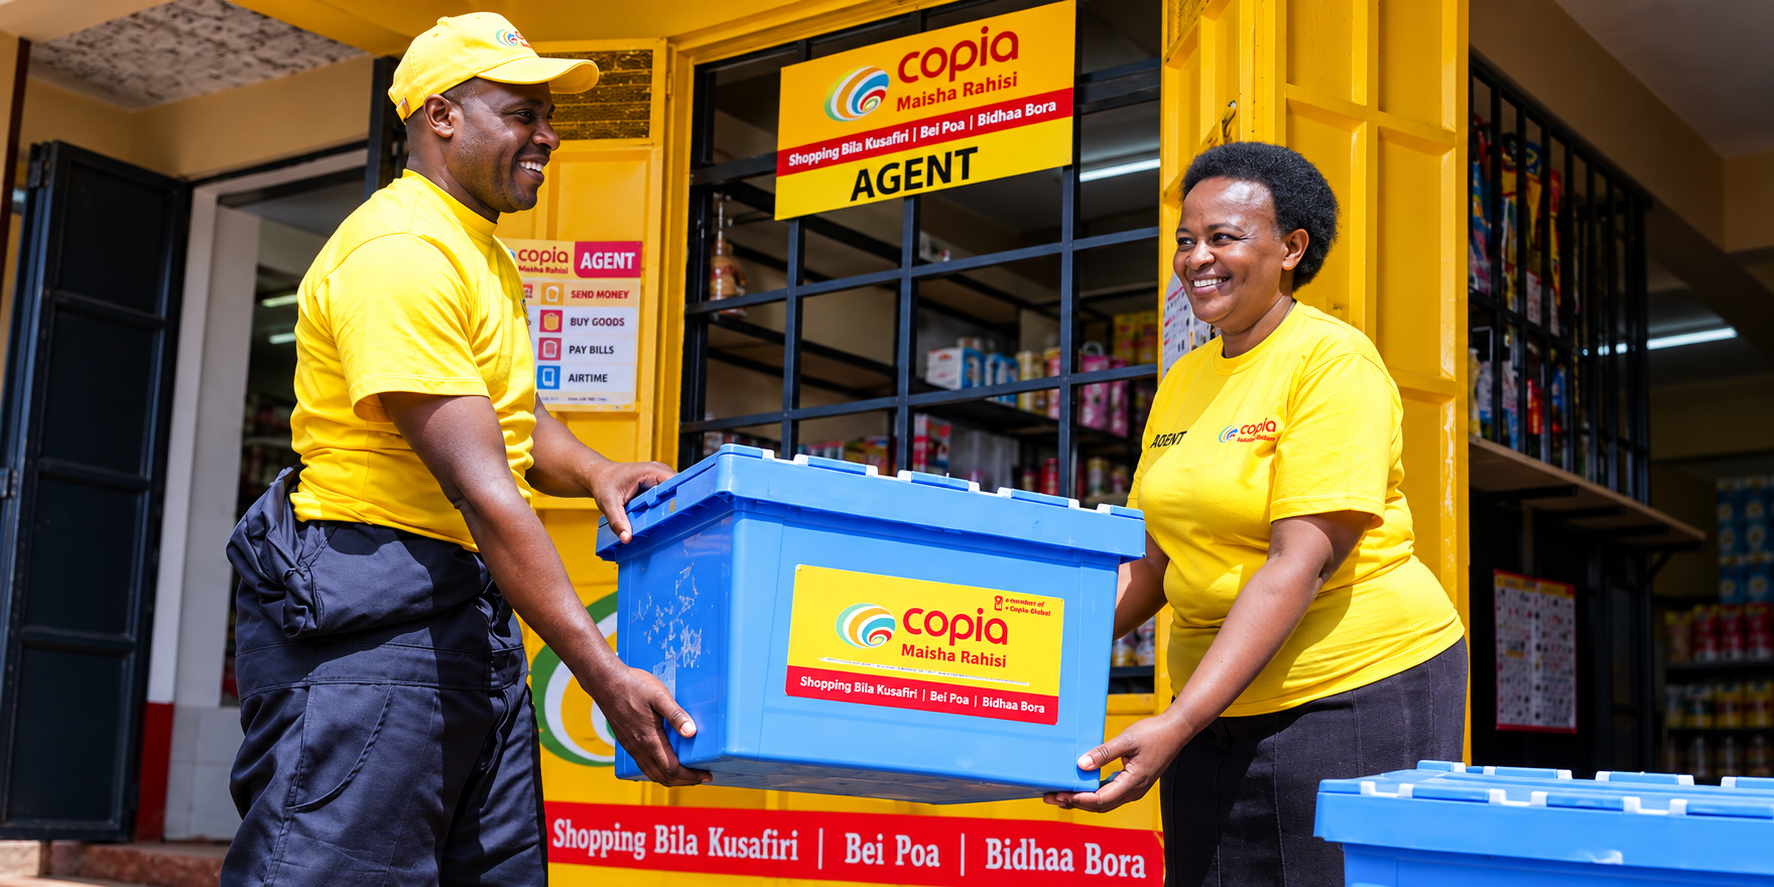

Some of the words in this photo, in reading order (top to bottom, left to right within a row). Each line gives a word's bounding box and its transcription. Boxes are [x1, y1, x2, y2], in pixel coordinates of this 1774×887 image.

[898, 25, 1019, 83] copia
[896, 88, 957, 112] Maisha
[962, 71, 1018, 99] Rahisi
[788, 146, 839, 167] Shopping
[841, 139, 863, 156] Bila
[865, 129, 909, 151] Kusafiri
[920, 123, 940, 139] Bei
[942, 120, 965, 135] Poa
[977, 107, 1022, 127] Bidhaa
[1025, 100, 1057, 117] Bora
[850, 146, 978, 202] AGENT
[518, 246, 569, 266] copia
[580, 252, 635, 269] AGENT
[571, 290, 594, 299] SEND
[596, 290, 630, 299] MONEY
[570, 317, 589, 327] BUY
[592, 317, 625, 327] GOODS
[569, 345, 587, 354] PAY
[589, 345, 614, 354] BILLS
[568, 374, 608, 383] AIRTIME
[1240, 417, 1277, 436] copia
[902, 607, 1009, 647] copia
[901, 643, 957, 664] Maisha
[961, 649, 1007, 669] Rahisi
[800, 676, 851, 694] Shopping
[853, 680, 875, 695] Bila
[877, 683, 918, 699] Kusafiri
[930, 690, 948, 703] Bei
[949, 692, 969, 706] Poa
[982, 696, 1019, 712] Bidhaa
[1020, 699, 1045, 714] Bora
[553, 818, 646, 860] Shopping
[654, 824, 699, 856] Bila
[707, 826, 799, 861] Kusafiri
[844, 832, 885, 865] Bei
[895, 834, 940, 868] Poa
[985, 837, 1075, 872] Bidhaa
[1084, 842, 1146, 879] Bora
